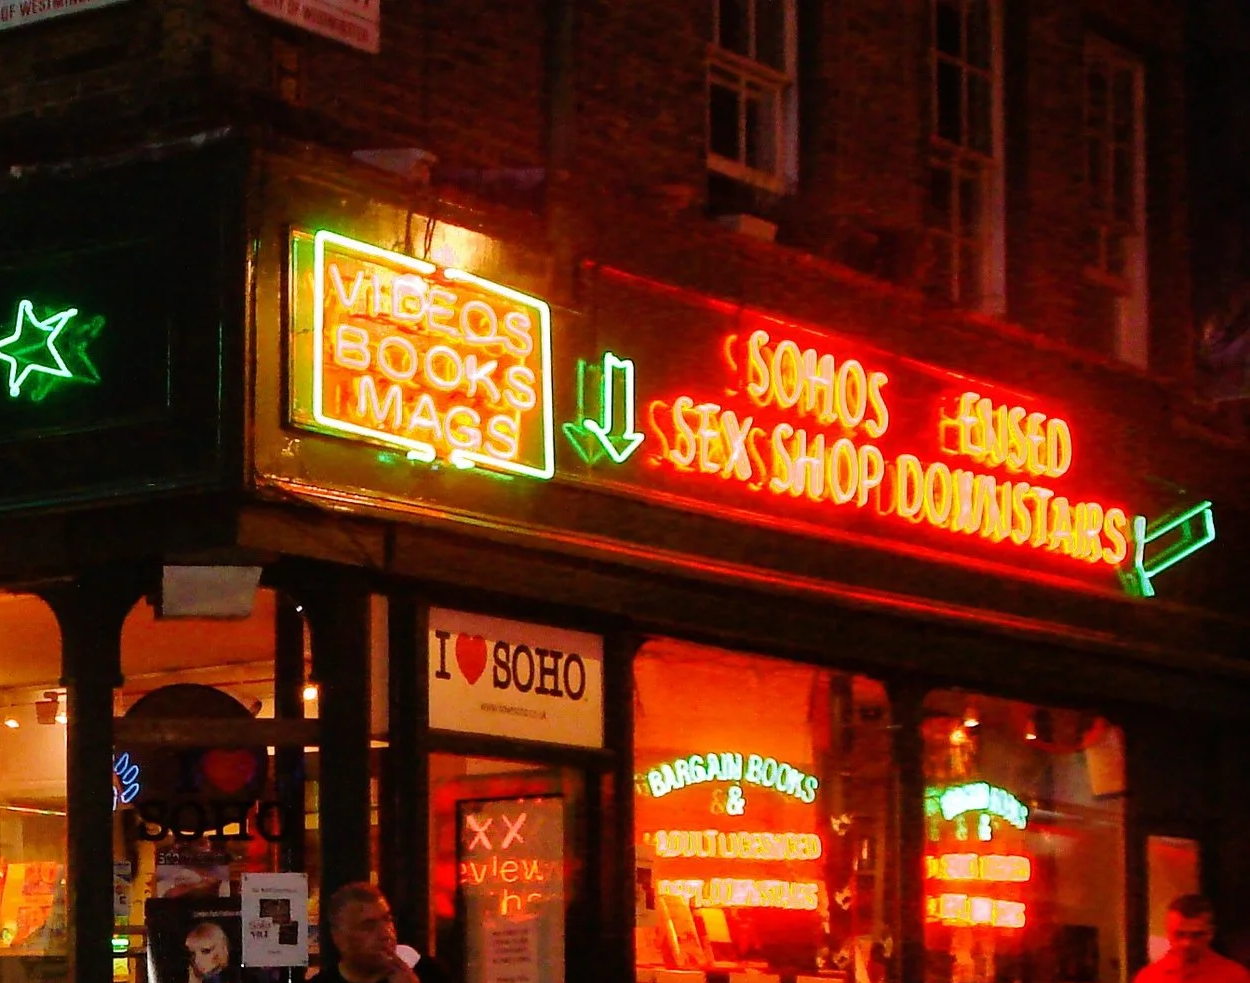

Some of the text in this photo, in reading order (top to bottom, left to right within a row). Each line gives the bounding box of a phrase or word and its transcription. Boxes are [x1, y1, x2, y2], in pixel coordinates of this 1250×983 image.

[0, 6, 16, 22] OF
[330, 263, 534, 358] VIDEOS
[334, 324, 537, 412] BOOKS
[747, 329, 889, 438] SOHOS
[357, 375, 518, 461] MAGS
[671, 395, 1128, 564] SEX SHOP DOWNSTAIRS
[435, 629, 587, 701] I SOHO
[647, 752, 820, 804] BARGAIN BOOKS
[725, 786, 746, 817] &
